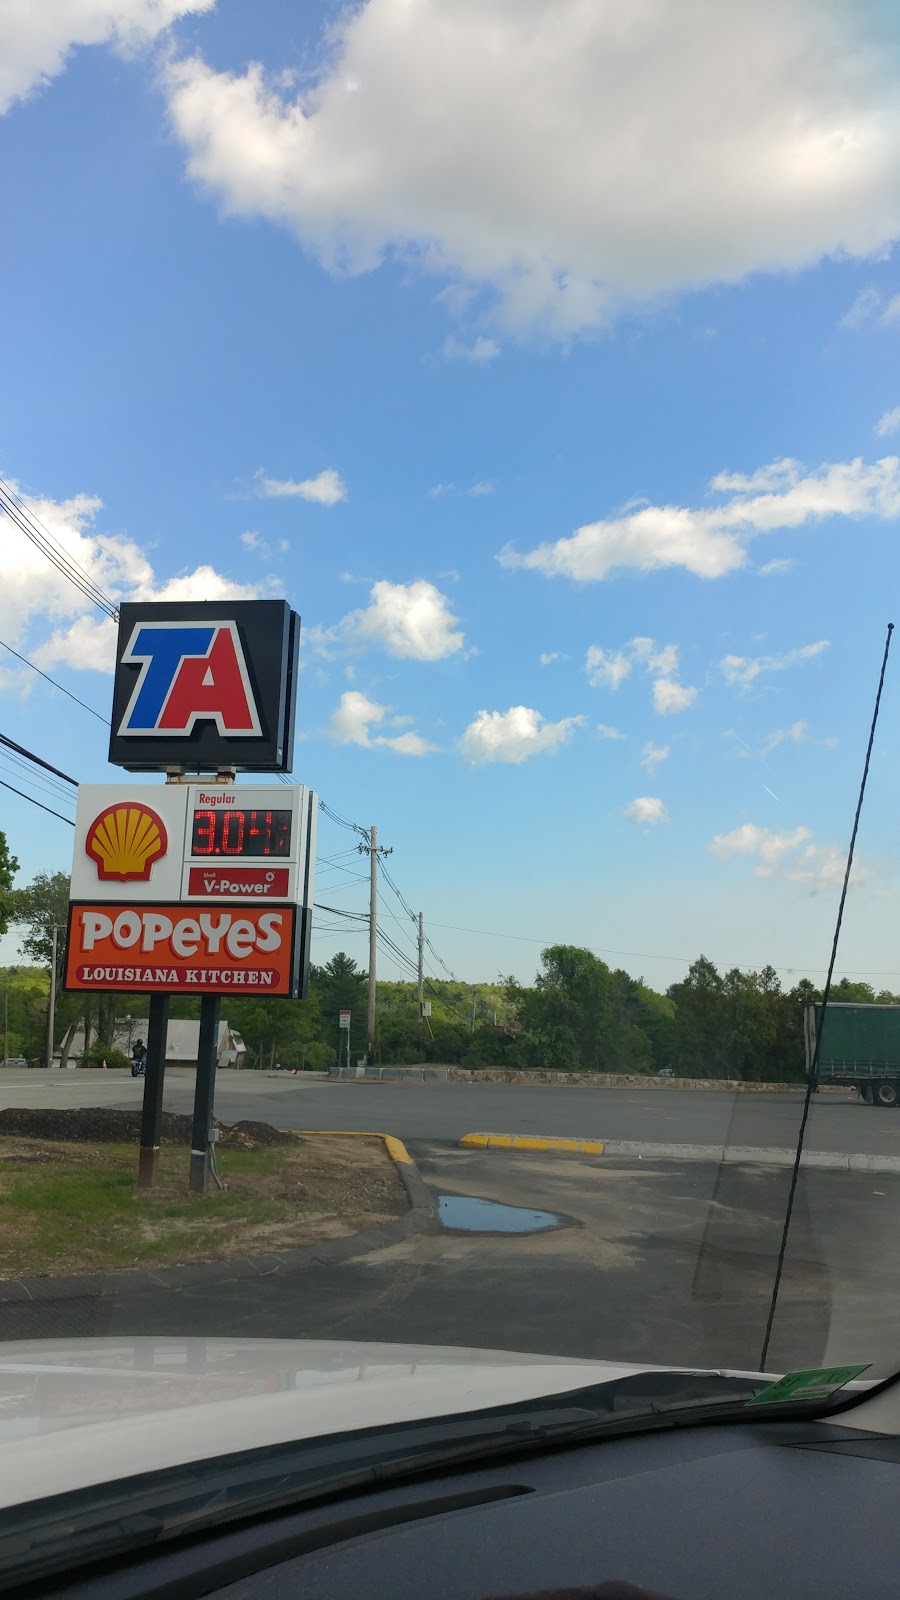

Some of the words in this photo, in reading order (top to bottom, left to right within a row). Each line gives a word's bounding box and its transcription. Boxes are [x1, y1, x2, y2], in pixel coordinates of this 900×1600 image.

[117, 620, 263, 737] TA
[199, 793, 236, 806] Regular
[203, 880, 271, 893] V-Power
[82, 967, 179, 983] LOUISIANA
[185, 969, 273, 984] KITCHEN
